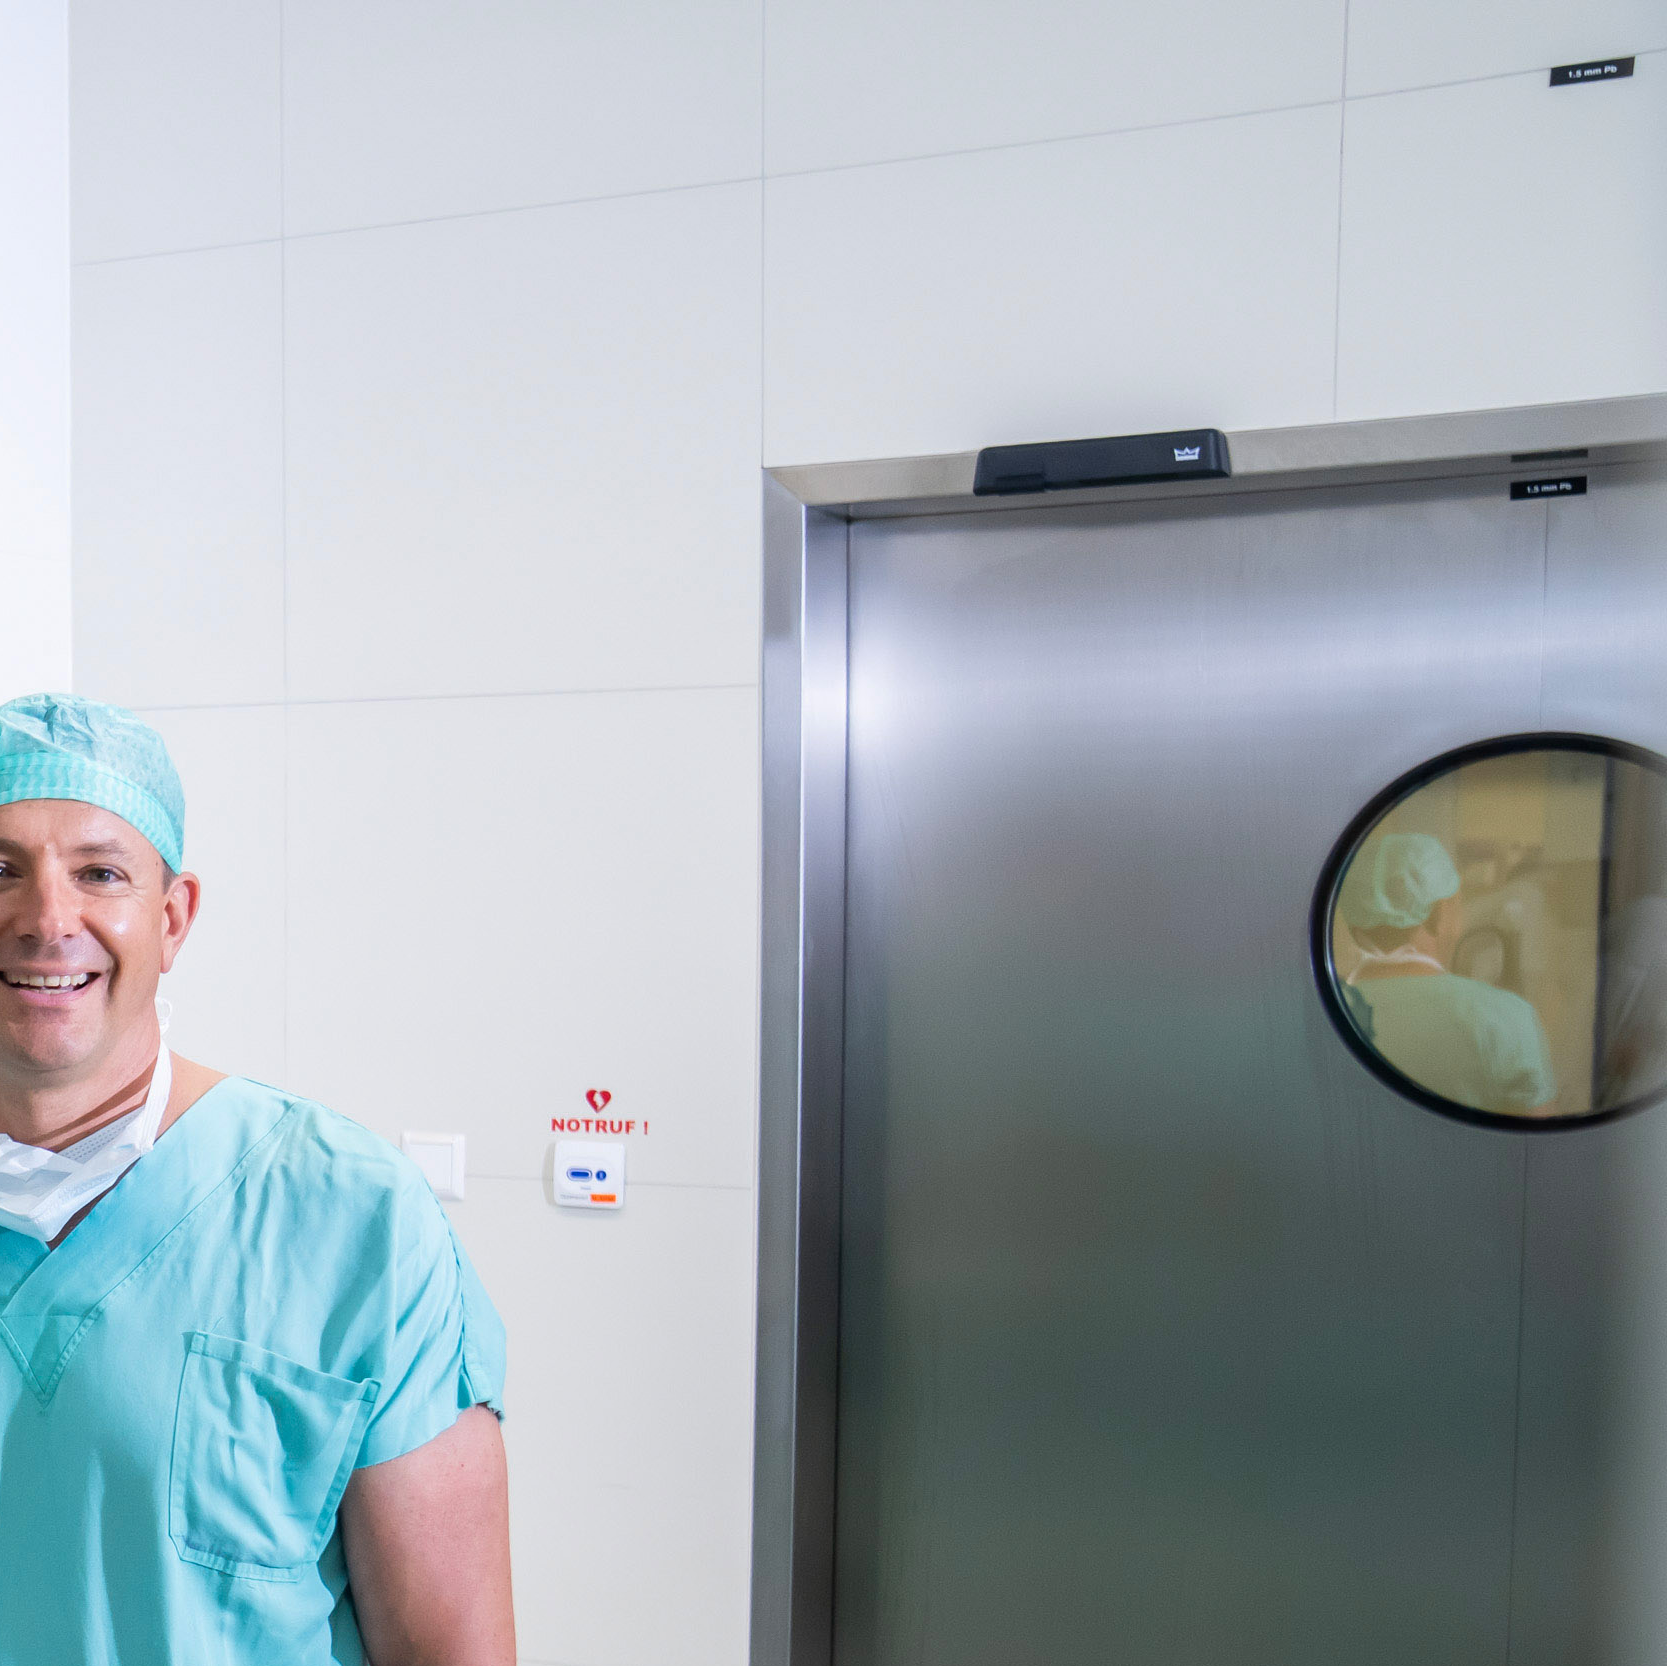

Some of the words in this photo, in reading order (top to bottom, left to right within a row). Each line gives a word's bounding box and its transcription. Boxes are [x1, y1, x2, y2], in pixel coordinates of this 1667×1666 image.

[1568, 69, 1581, 78] 1.5
[1584, 67, 1602, 76] mm
[1527, 484, 1540, 494] 1.5
[551, 1118, 636, 1135] NOTRUF
[643, 1121, 649, 1135] !
